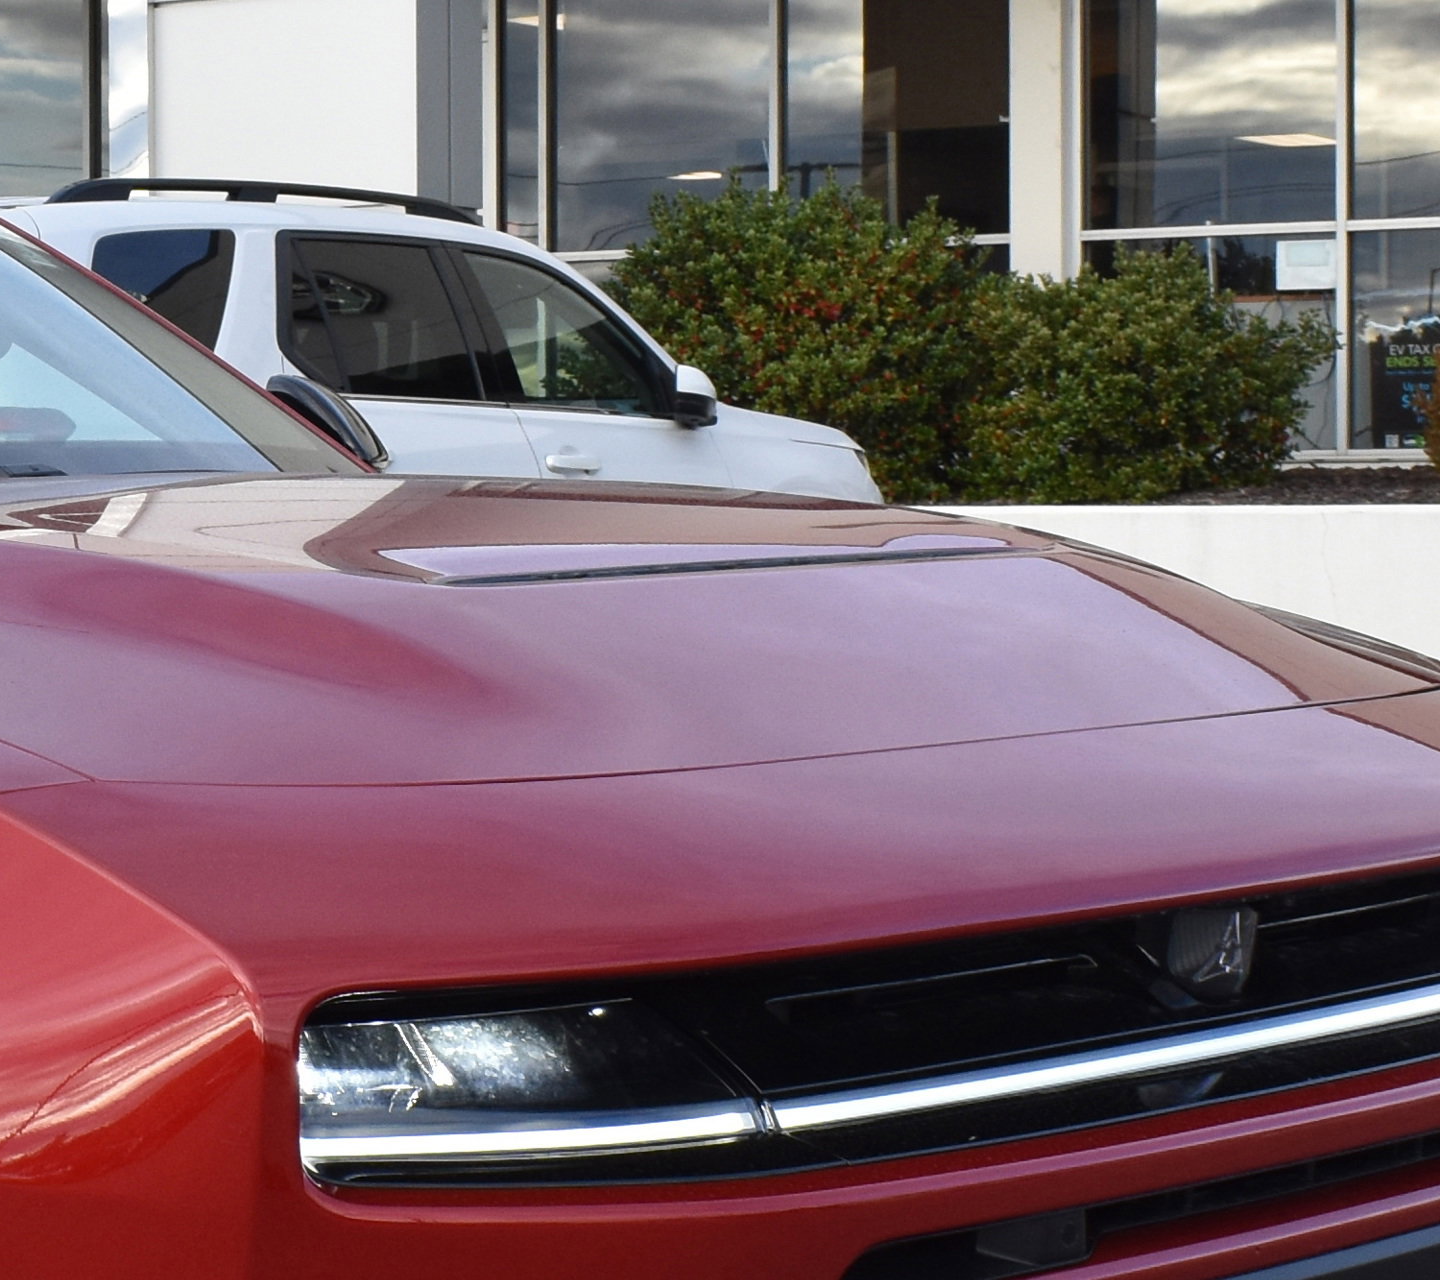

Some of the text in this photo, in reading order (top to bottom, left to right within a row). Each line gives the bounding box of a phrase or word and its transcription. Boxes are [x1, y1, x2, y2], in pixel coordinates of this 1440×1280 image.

[1389, 344, 1405, 355] EV
[1408, 343, 1430, 354] TAX
[1386, 356, 1419, 367] ENDS
